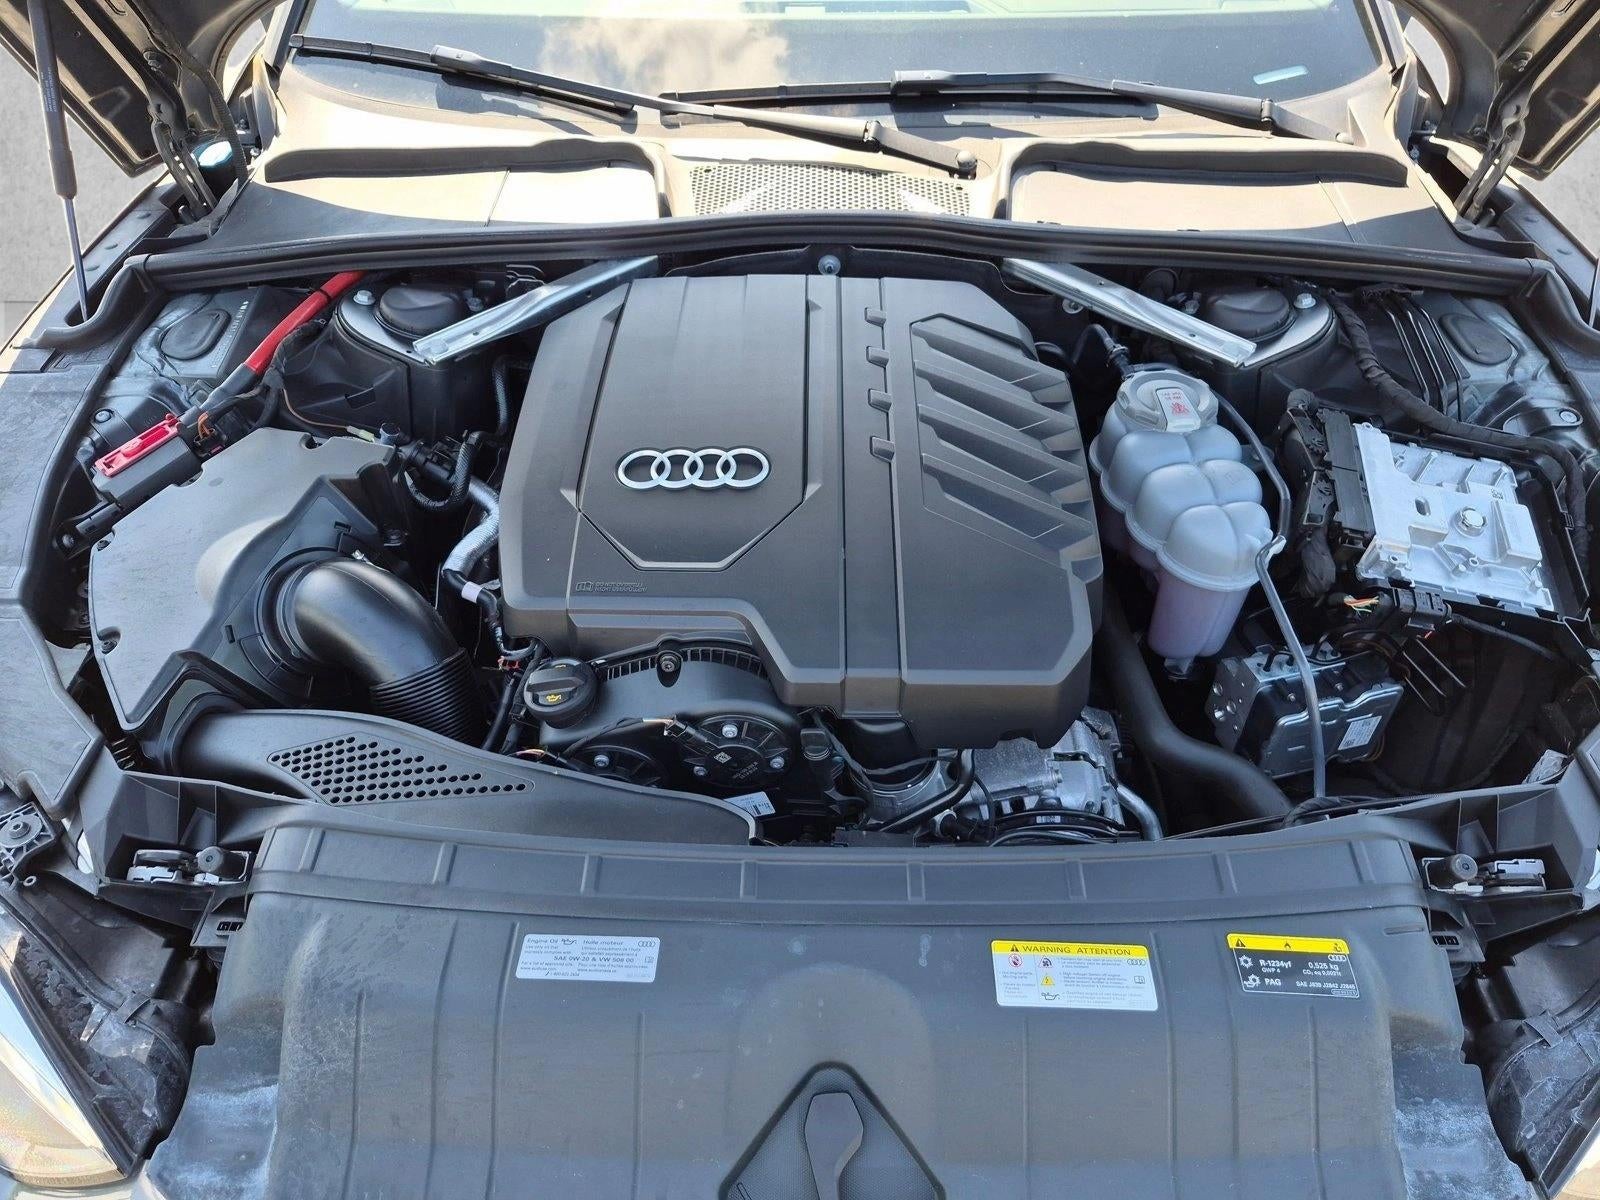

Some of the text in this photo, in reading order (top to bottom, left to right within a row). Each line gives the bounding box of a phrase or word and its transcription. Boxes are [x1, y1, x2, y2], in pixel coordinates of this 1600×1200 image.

[1022, 945, 1071, 954] WARNING
[1076, 947, 1131, 956] ATTENTION
[1259, 959, 1292, 969] R-1234yf
[1329, 963, 1339, 971] kg
[1264, 977, 1282, 986] PAG
